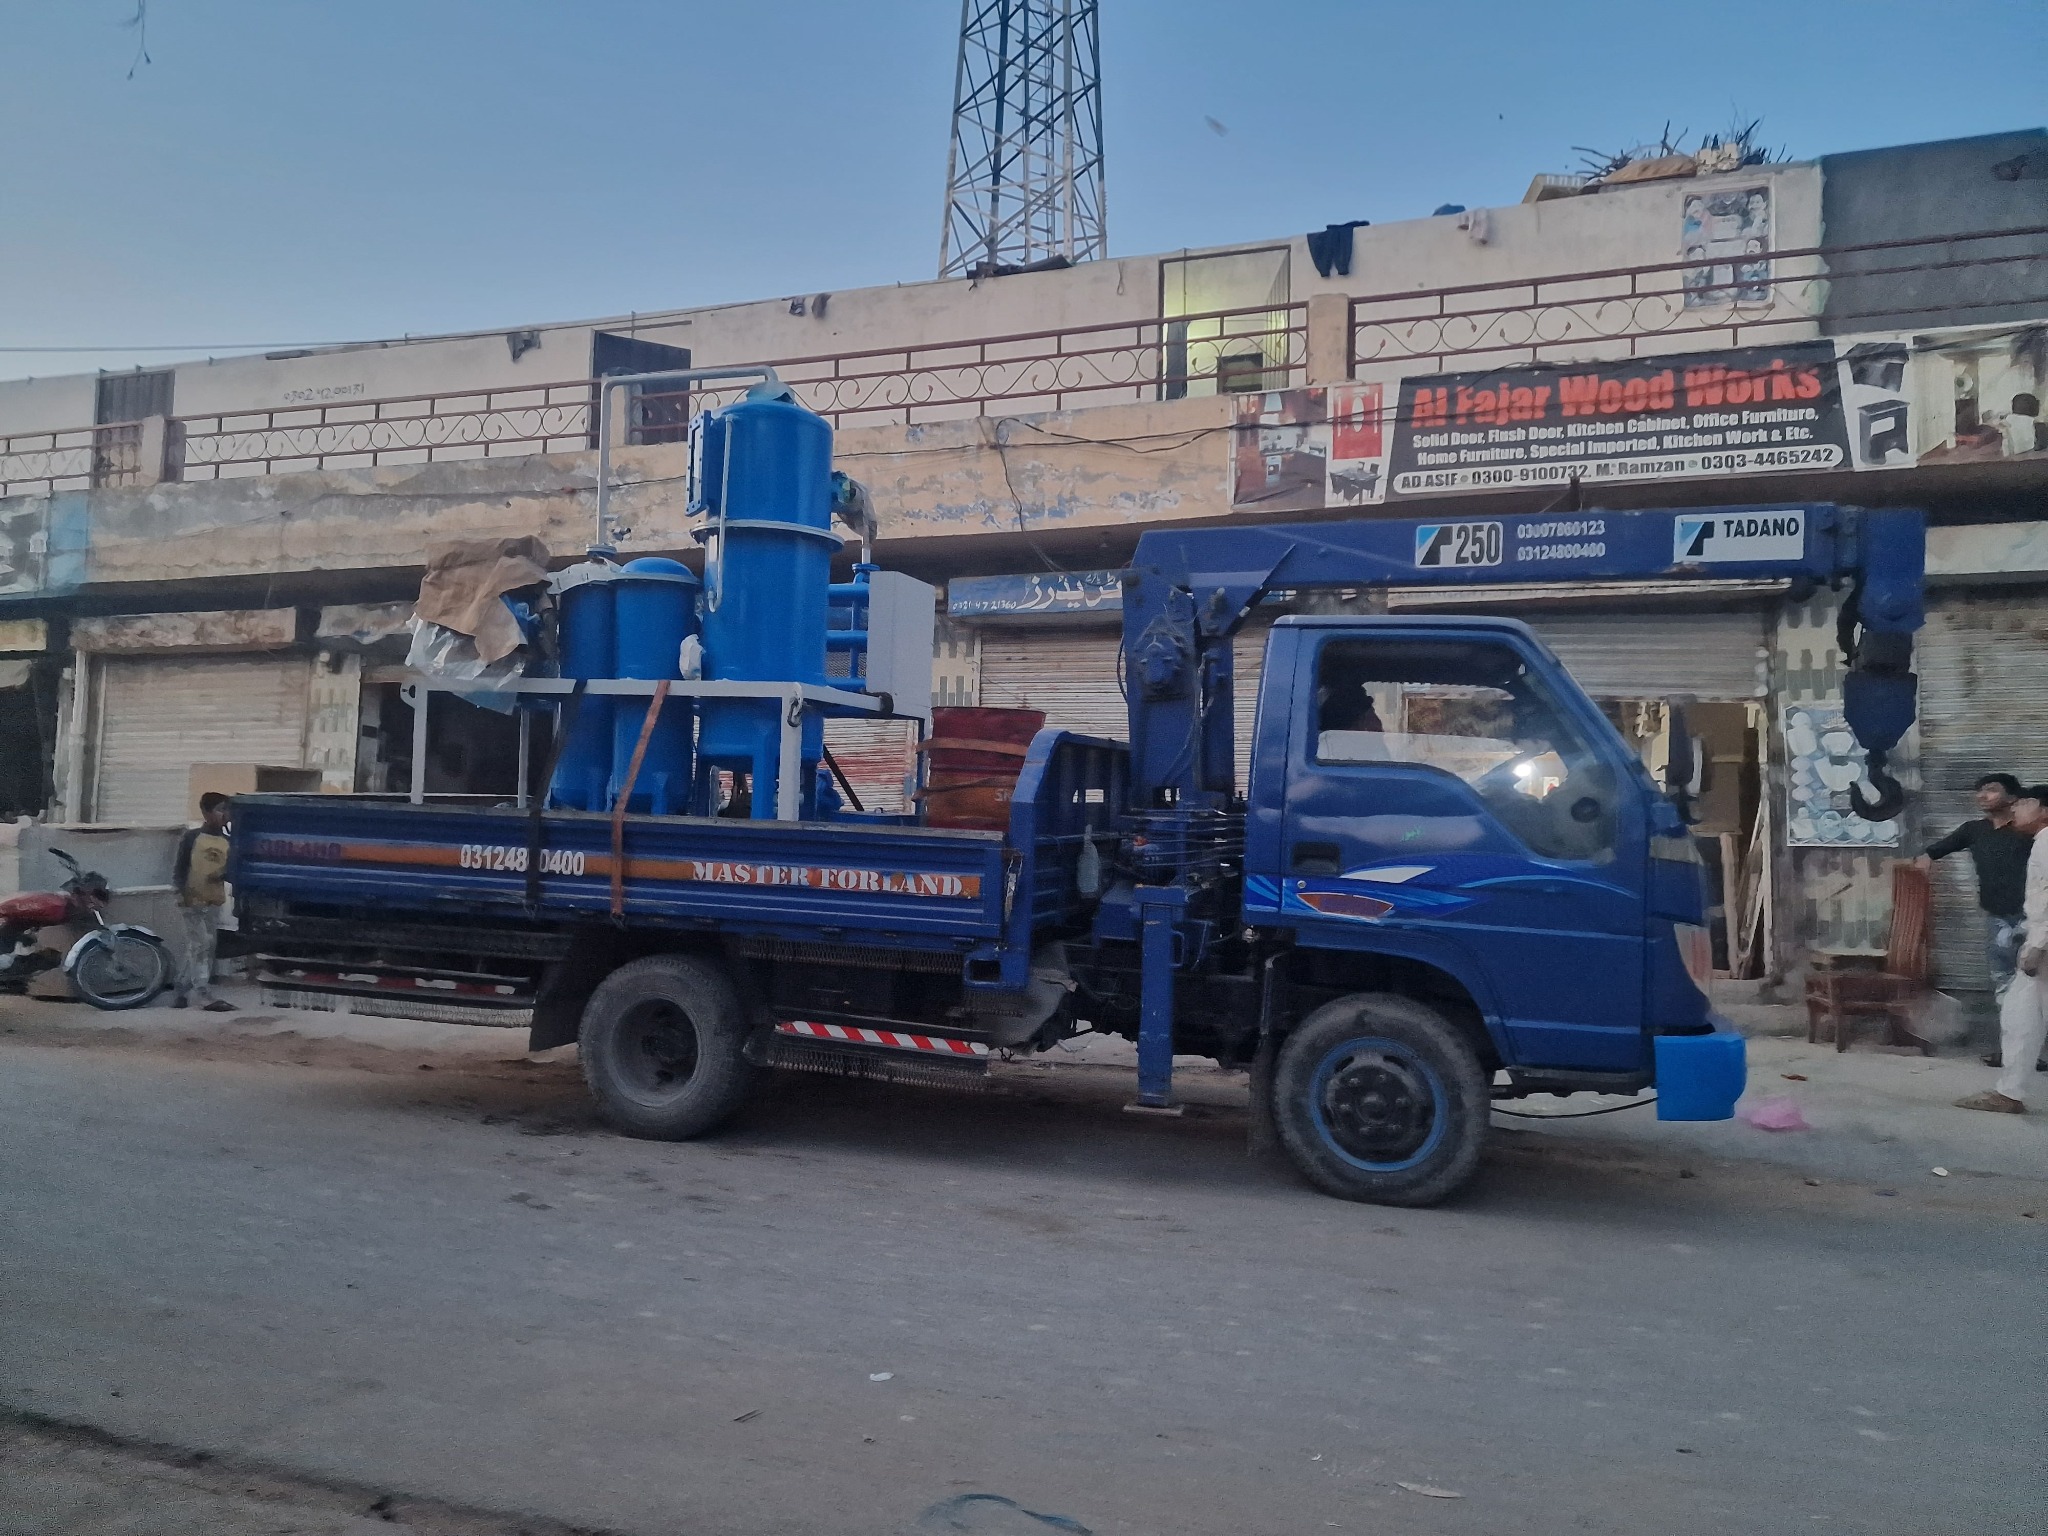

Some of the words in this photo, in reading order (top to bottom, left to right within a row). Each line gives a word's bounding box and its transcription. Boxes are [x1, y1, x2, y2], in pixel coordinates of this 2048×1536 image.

[1411, 387, 1448, 428] Al
[1456, 382, 1551, 426] Fajar
[1559, 369, 1675, 417] Wood
[1685, 359, 1822, 407] Works
[1413, 432, 1449, 448] Solid
[1450, 429, 1486, 446] Door,
[1488, 425, 1526, 443] Flush
[1528, 424, 1565, 441] Door,
[1567, 421, 1625, 438] Kitchen
[1627, 415, 1690, 434] Cabinet,
[1693, 411, 1738, 429] Office
[1742, 406, 1819, 425] Furniture,
[1417, 450, 1458, 466] Home
[1460, 446, 1528, 463] Furniture,
[1530, 441, 1585, 459] Special
[1587, 436, 1660, 456] Imported,
[1662, 432, 1723, 450] Kitchen
[1726, 428, 1768, 445] Work
[1771, 427, 1783, 443] &
[1785, 425, 1814, 441] Etc.
[1401, 475, 1421, 489] AD
[1424, 472, 1458, 487] ASIF
[1618, 458, 1686, 476] Ramzan
[1701, 448, 1834, 470] 0303-4465242
[1455, 522, 1501, 565] 250
[1723, 517, 1800, 538] TADANO
[460, 844, 585, 876] 0312480400
[691, 860, 810, 887] MASTER
[820, 867, 964, 897] FORLAND
